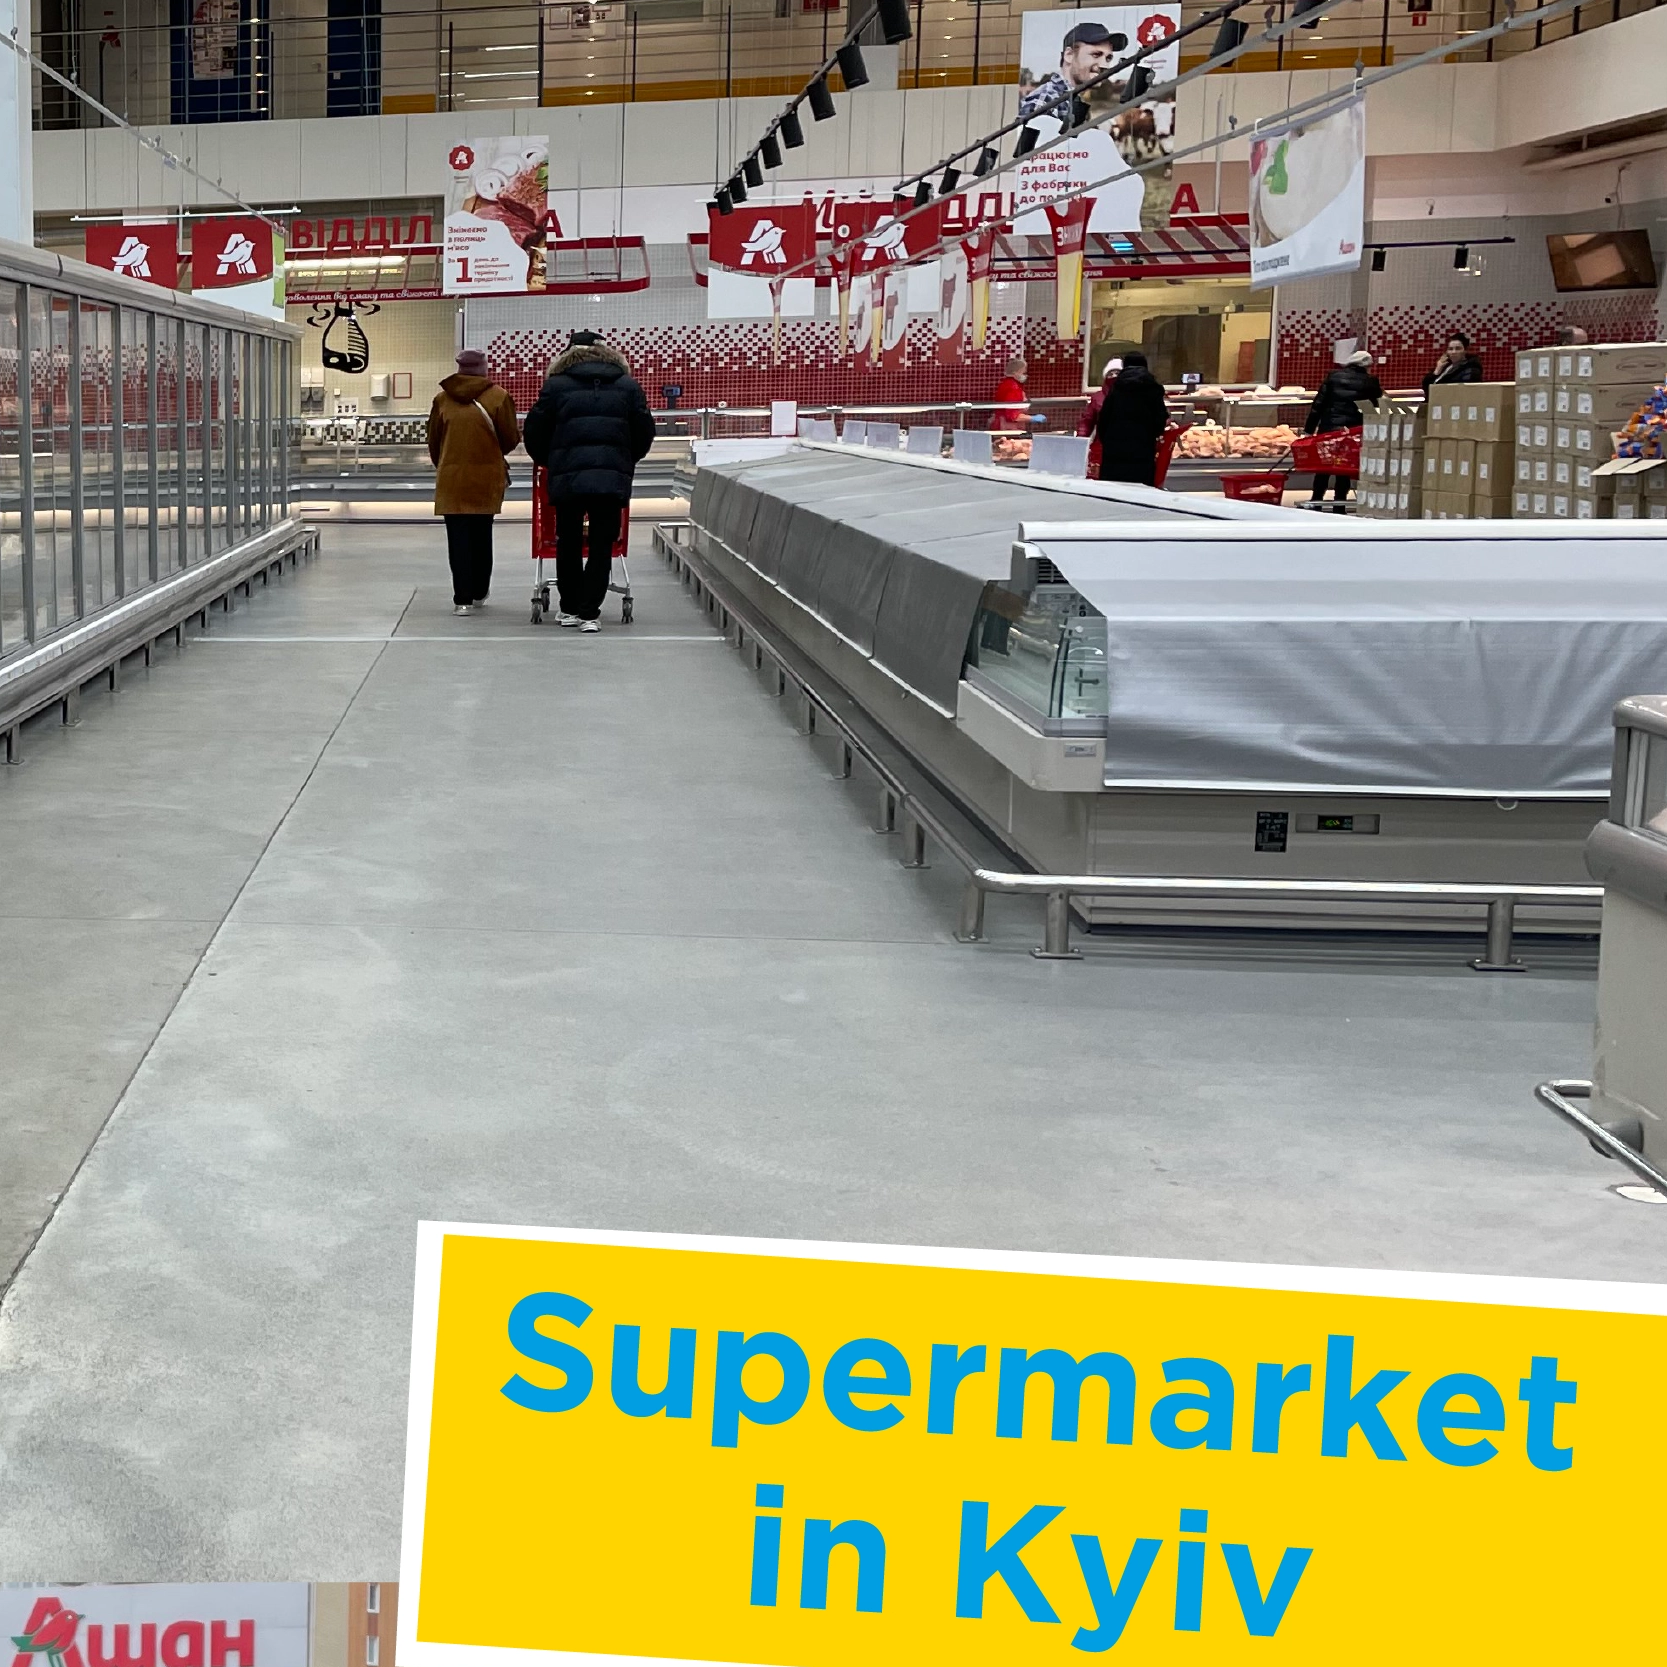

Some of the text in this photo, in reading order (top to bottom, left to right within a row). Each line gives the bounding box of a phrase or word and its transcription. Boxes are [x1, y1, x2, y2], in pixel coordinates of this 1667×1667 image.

[1021, 163, 1071, 176] для Вас
[292, 215, 433, 251] ВІДДІЛ
[456, 257, 473, 283] 1
